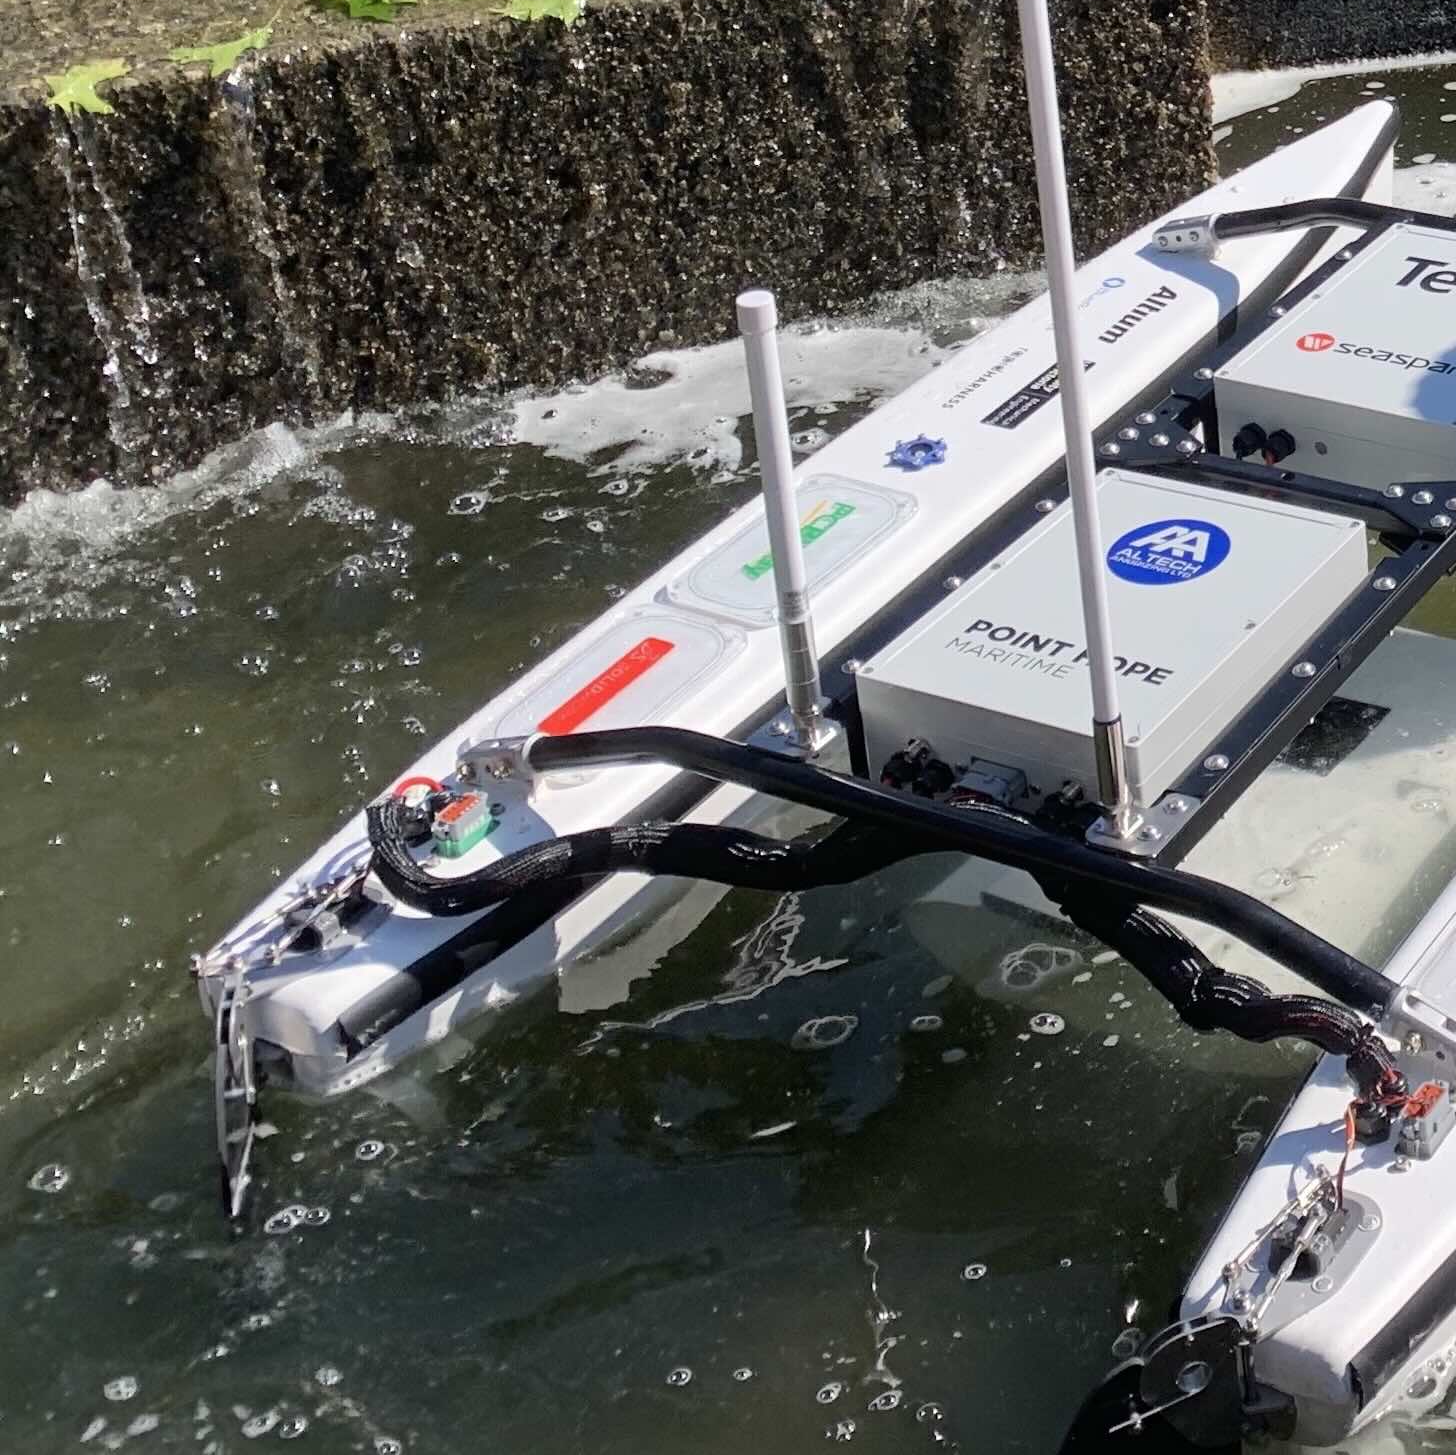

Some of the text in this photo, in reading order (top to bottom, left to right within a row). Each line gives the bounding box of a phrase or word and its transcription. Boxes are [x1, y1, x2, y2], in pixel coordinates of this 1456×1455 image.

[1098, 286, 1177, 344] Altium
[1115, 547, 1202, 574] ALTECH
[963, 619, 1075, 656] POINT
[944, 637, 1075, 679] MARITIME
